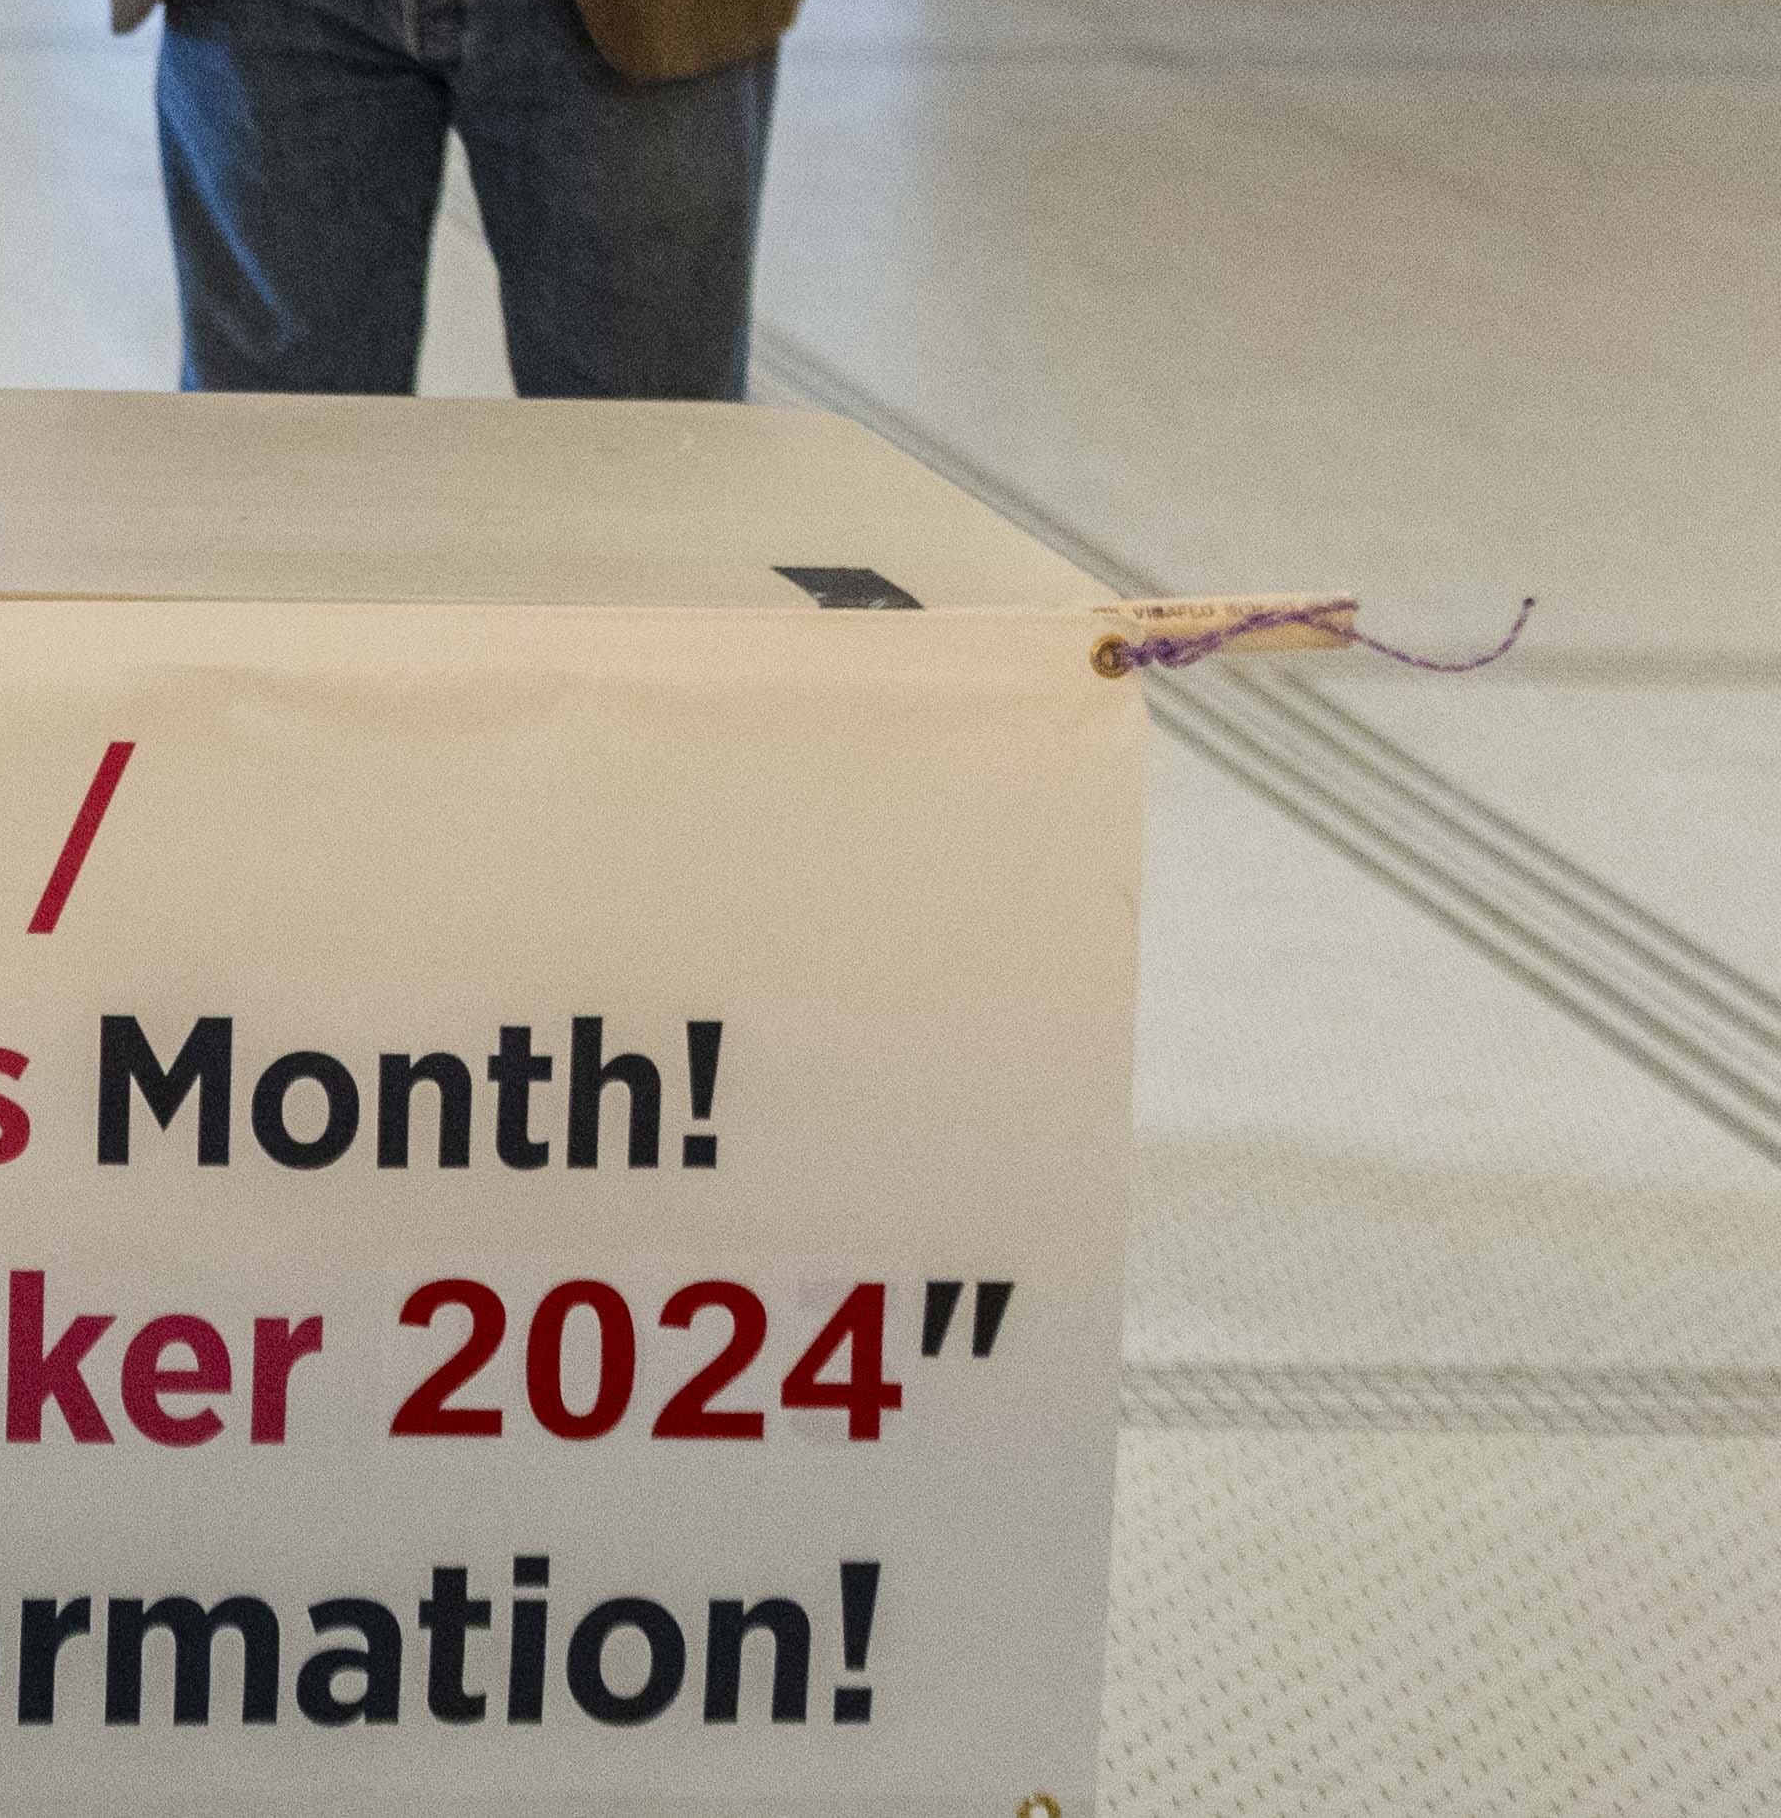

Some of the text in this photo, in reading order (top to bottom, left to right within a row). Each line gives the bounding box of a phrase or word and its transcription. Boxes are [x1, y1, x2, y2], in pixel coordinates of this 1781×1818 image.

[27, 741, 136, 935] /
[97, 1014, 725, 1171] Month!
[388, 1278, 1015, 1443] 2024"
